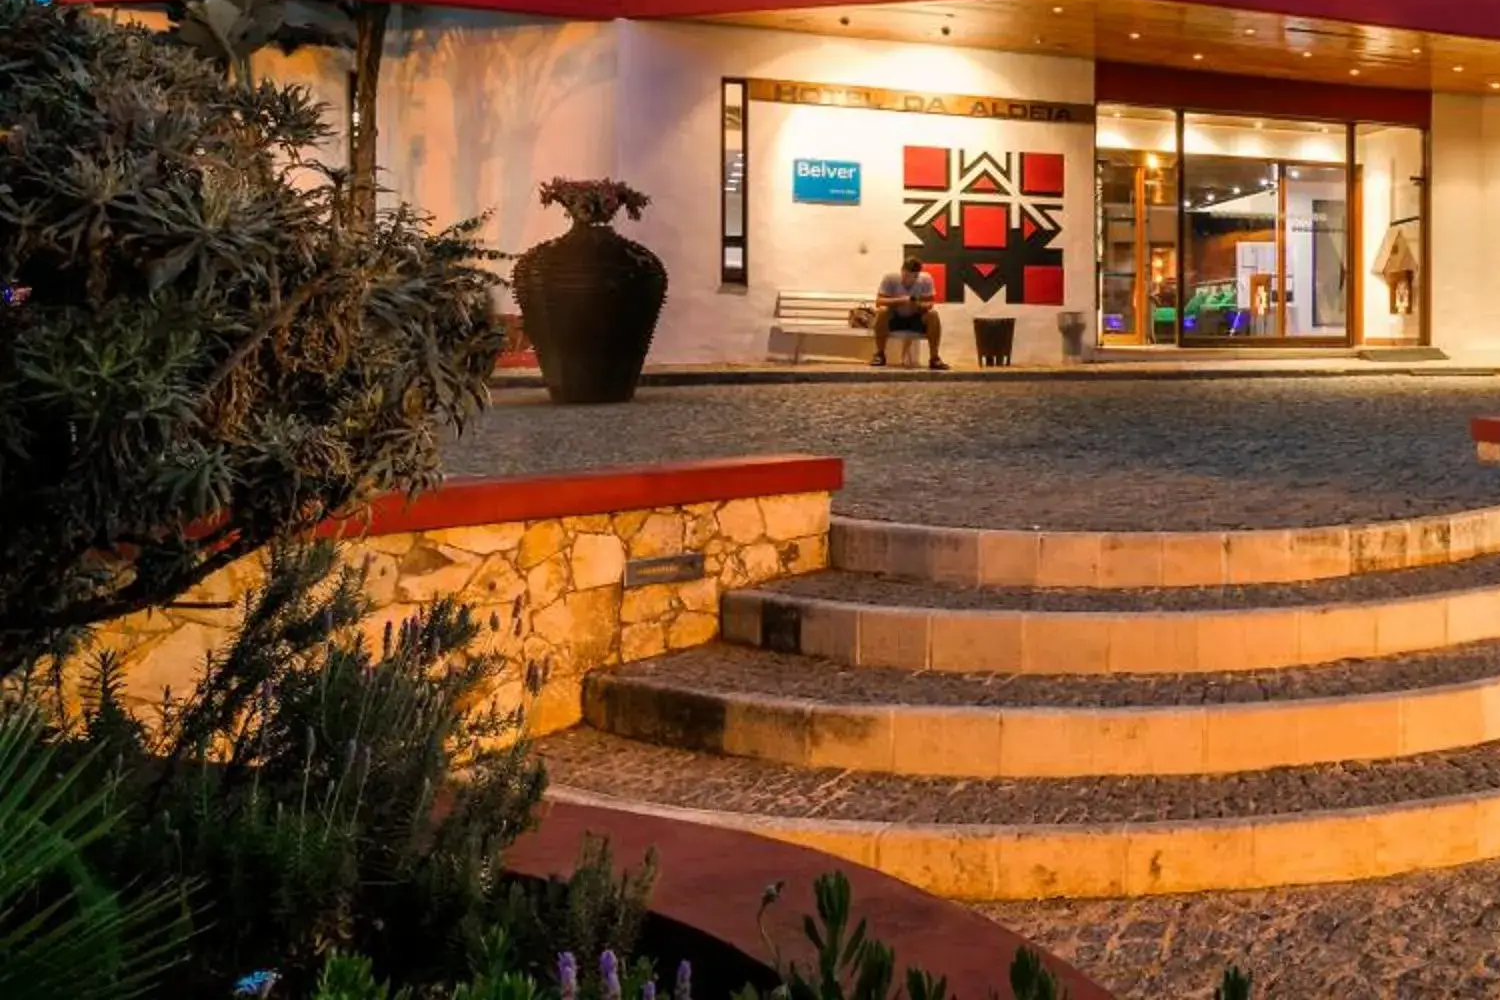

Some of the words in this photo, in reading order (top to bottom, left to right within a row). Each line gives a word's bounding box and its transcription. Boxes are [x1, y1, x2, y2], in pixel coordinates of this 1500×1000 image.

[775, 83, 883, 109] HOTEL
[903, 95, 948, 113] DA
[970, 101, 1071, 122] ALDEIA
[798, 160, 857, 179] Belver
